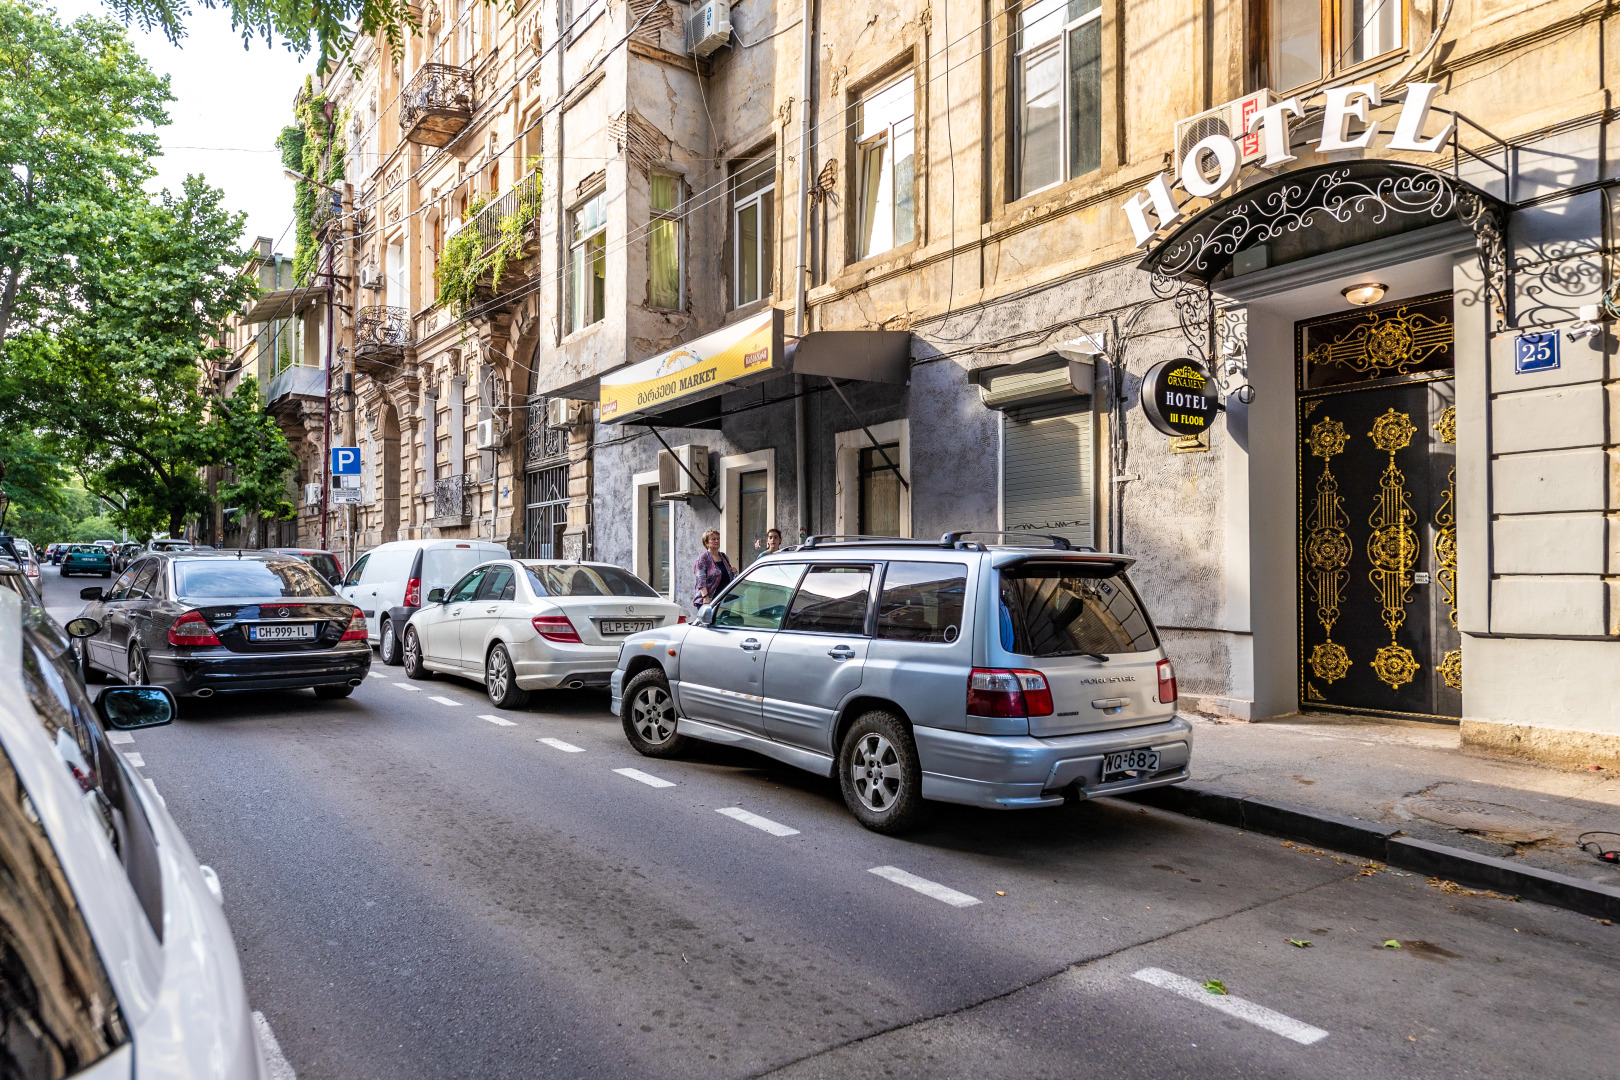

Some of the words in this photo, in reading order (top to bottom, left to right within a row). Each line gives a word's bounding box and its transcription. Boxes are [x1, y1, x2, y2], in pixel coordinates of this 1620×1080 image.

[1121, 82, 1456, 248] HOTEL
[1522, 341, 1551, 363] 25
[637, 381, 677, 405] მარკეტი
[679, 367, 717, 391] MARKET
[1167, 376, 1206, 389] ORNAMENT
[1166, 391, 1207, 410] HOTEL
[1170, 413, 1179, 423] III
[1181, 414, 1204, 426] FLOOR
[338, 450, 355, 472] P
[259, 627, 308, 638] CH-999-IL
[609, 622, 651, 632] LPE-777
[1080, 676, 1136, 685] FORESTER
